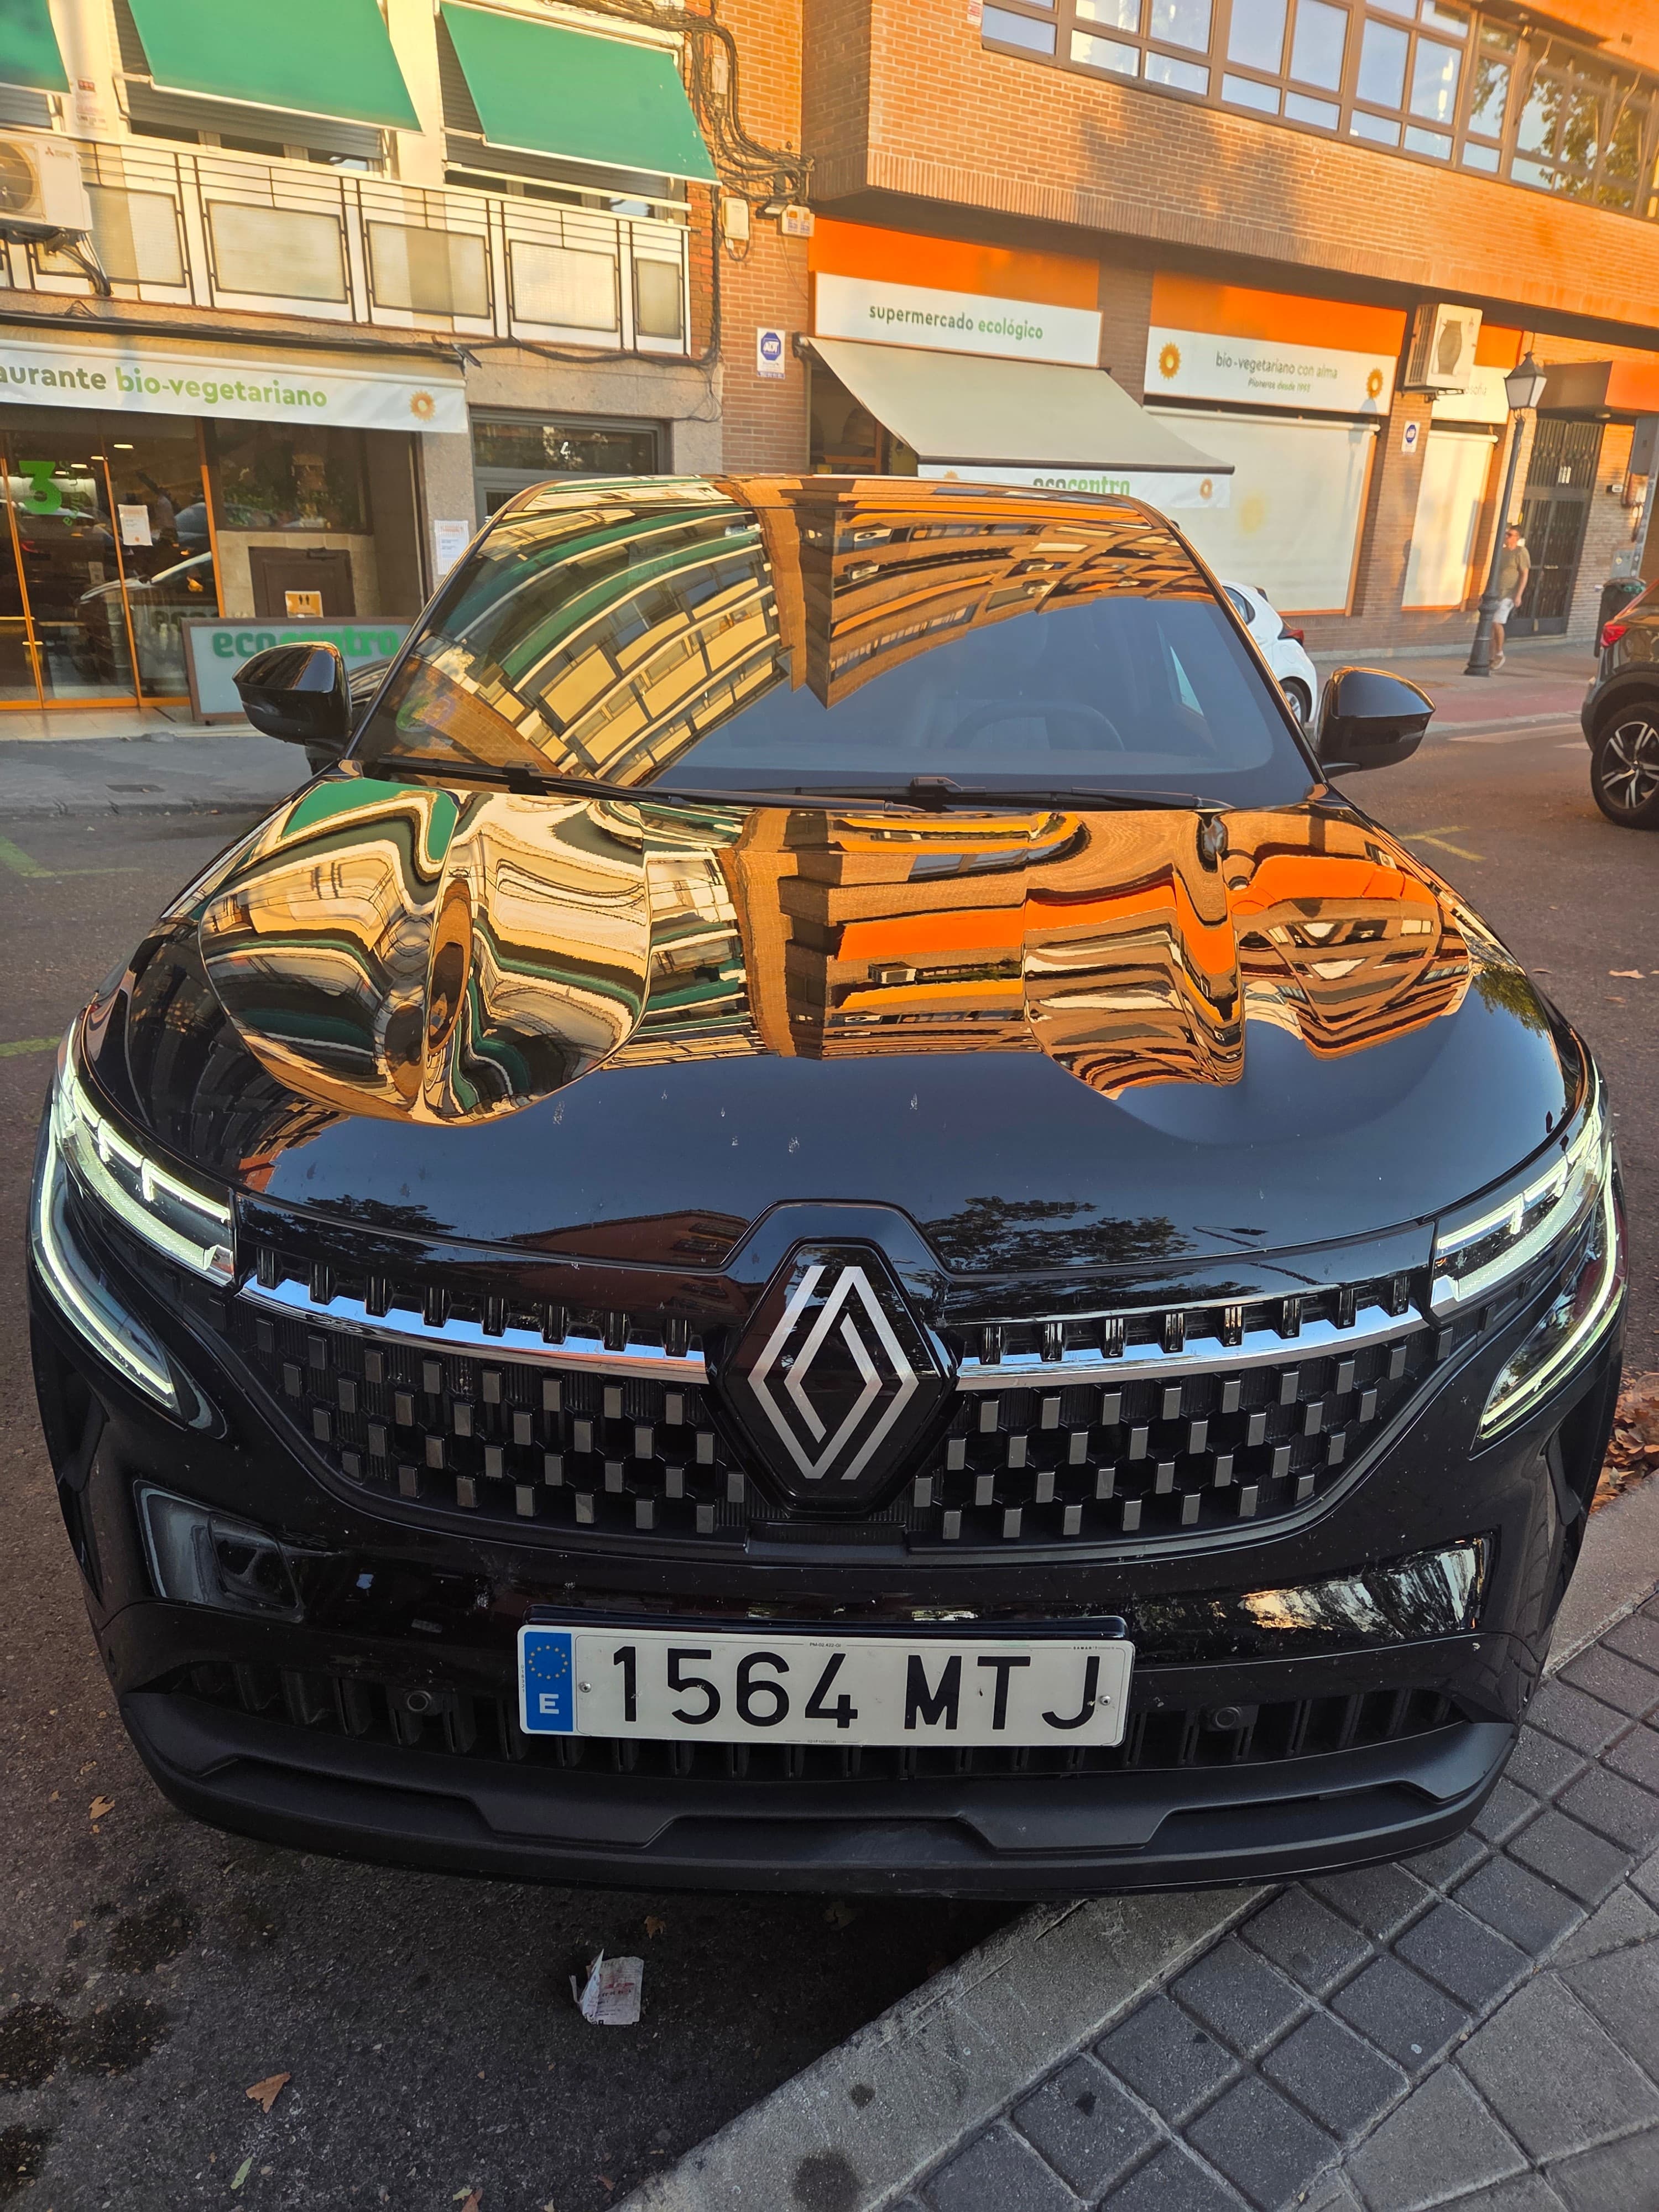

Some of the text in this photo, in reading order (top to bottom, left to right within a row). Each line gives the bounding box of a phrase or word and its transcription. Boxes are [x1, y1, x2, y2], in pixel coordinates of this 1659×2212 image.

[869, 305, 1044, 340] supermercado ecológico
[115, 366, 327, 408] bio-vegetariano
[1297, 363, 1314, 377] con
[1316, 363, 1338, 379] alma
[539, 1693, 560, 1715] E
[613, 1646, 1100, 1730] 1564 MTJ
